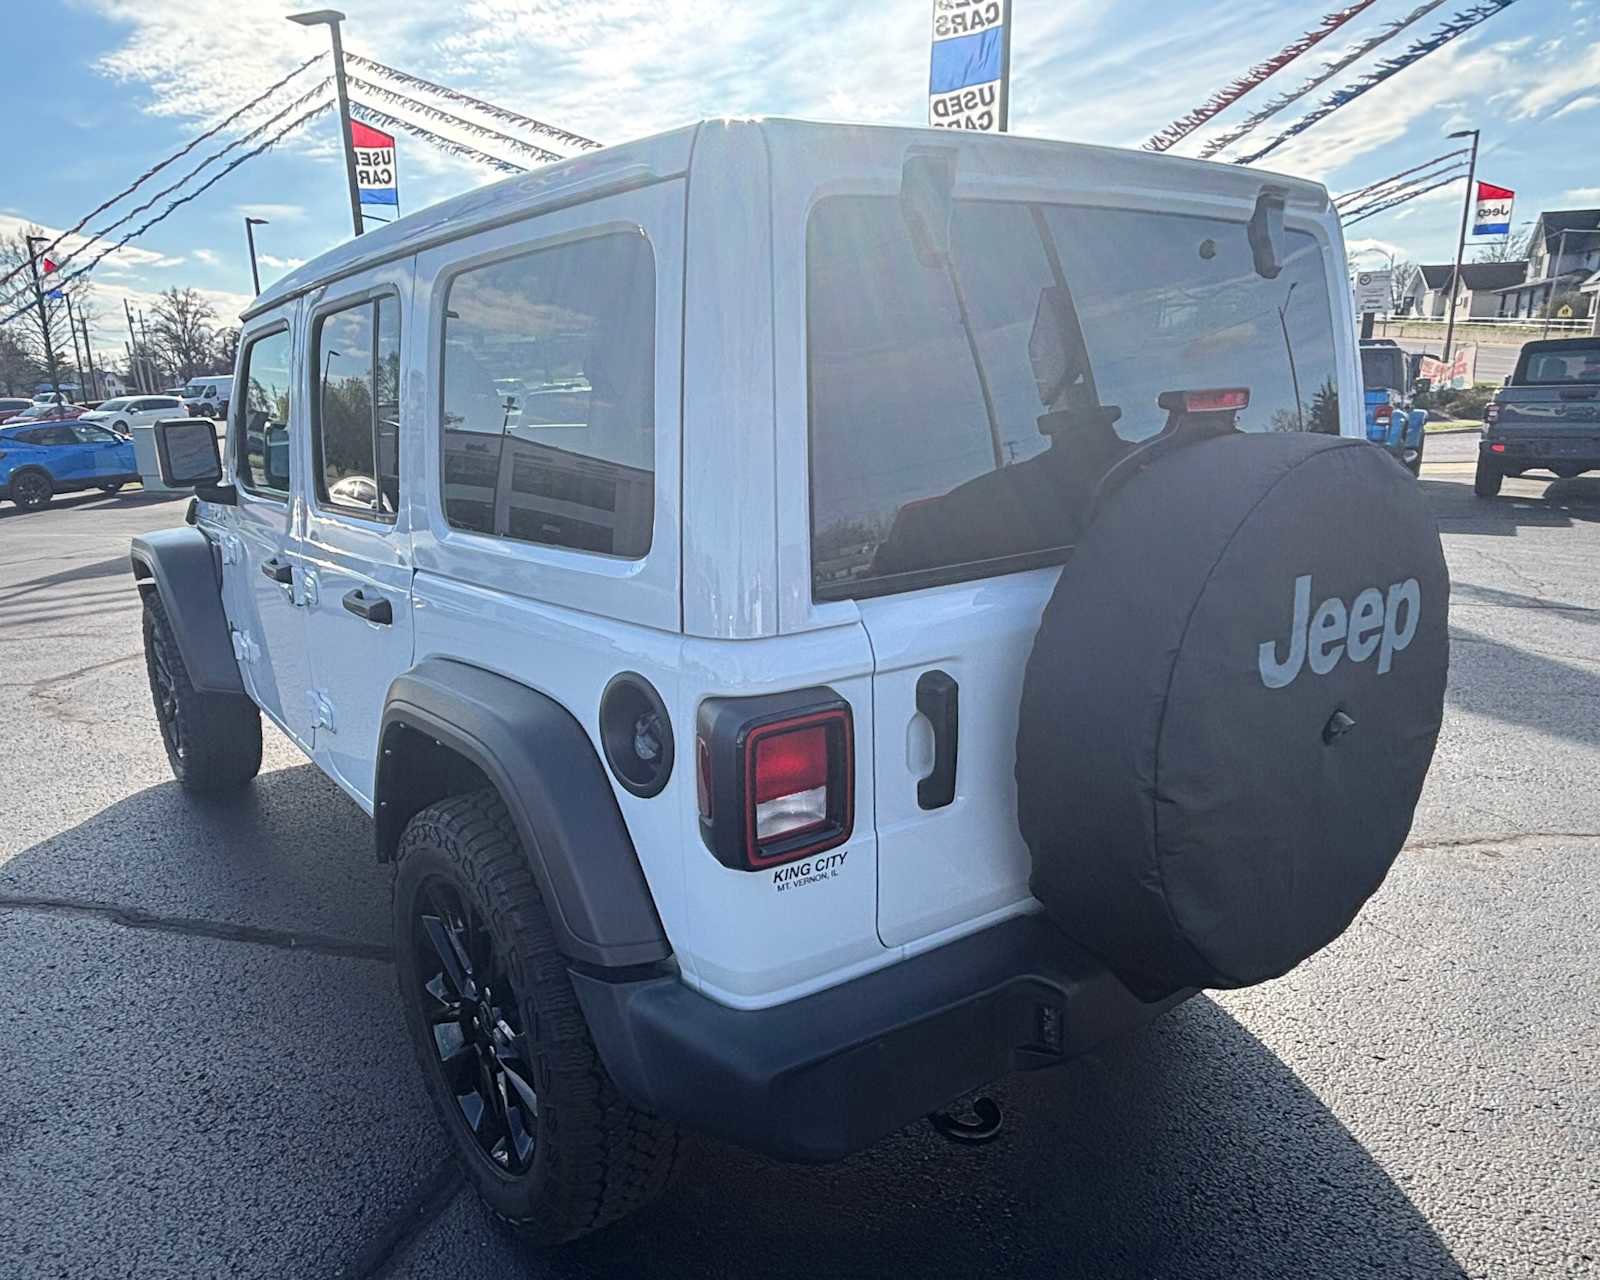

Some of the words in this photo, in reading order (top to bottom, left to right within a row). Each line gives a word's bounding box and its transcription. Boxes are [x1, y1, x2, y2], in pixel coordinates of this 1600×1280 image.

[1259, 575, 1421, 688] Jeep
[773, 863, 811, 884] KING
[815, 851, 848, 872] CITY
[793, 872, 829, 888] VERNON,
[831, 869, 838, 877] IL
